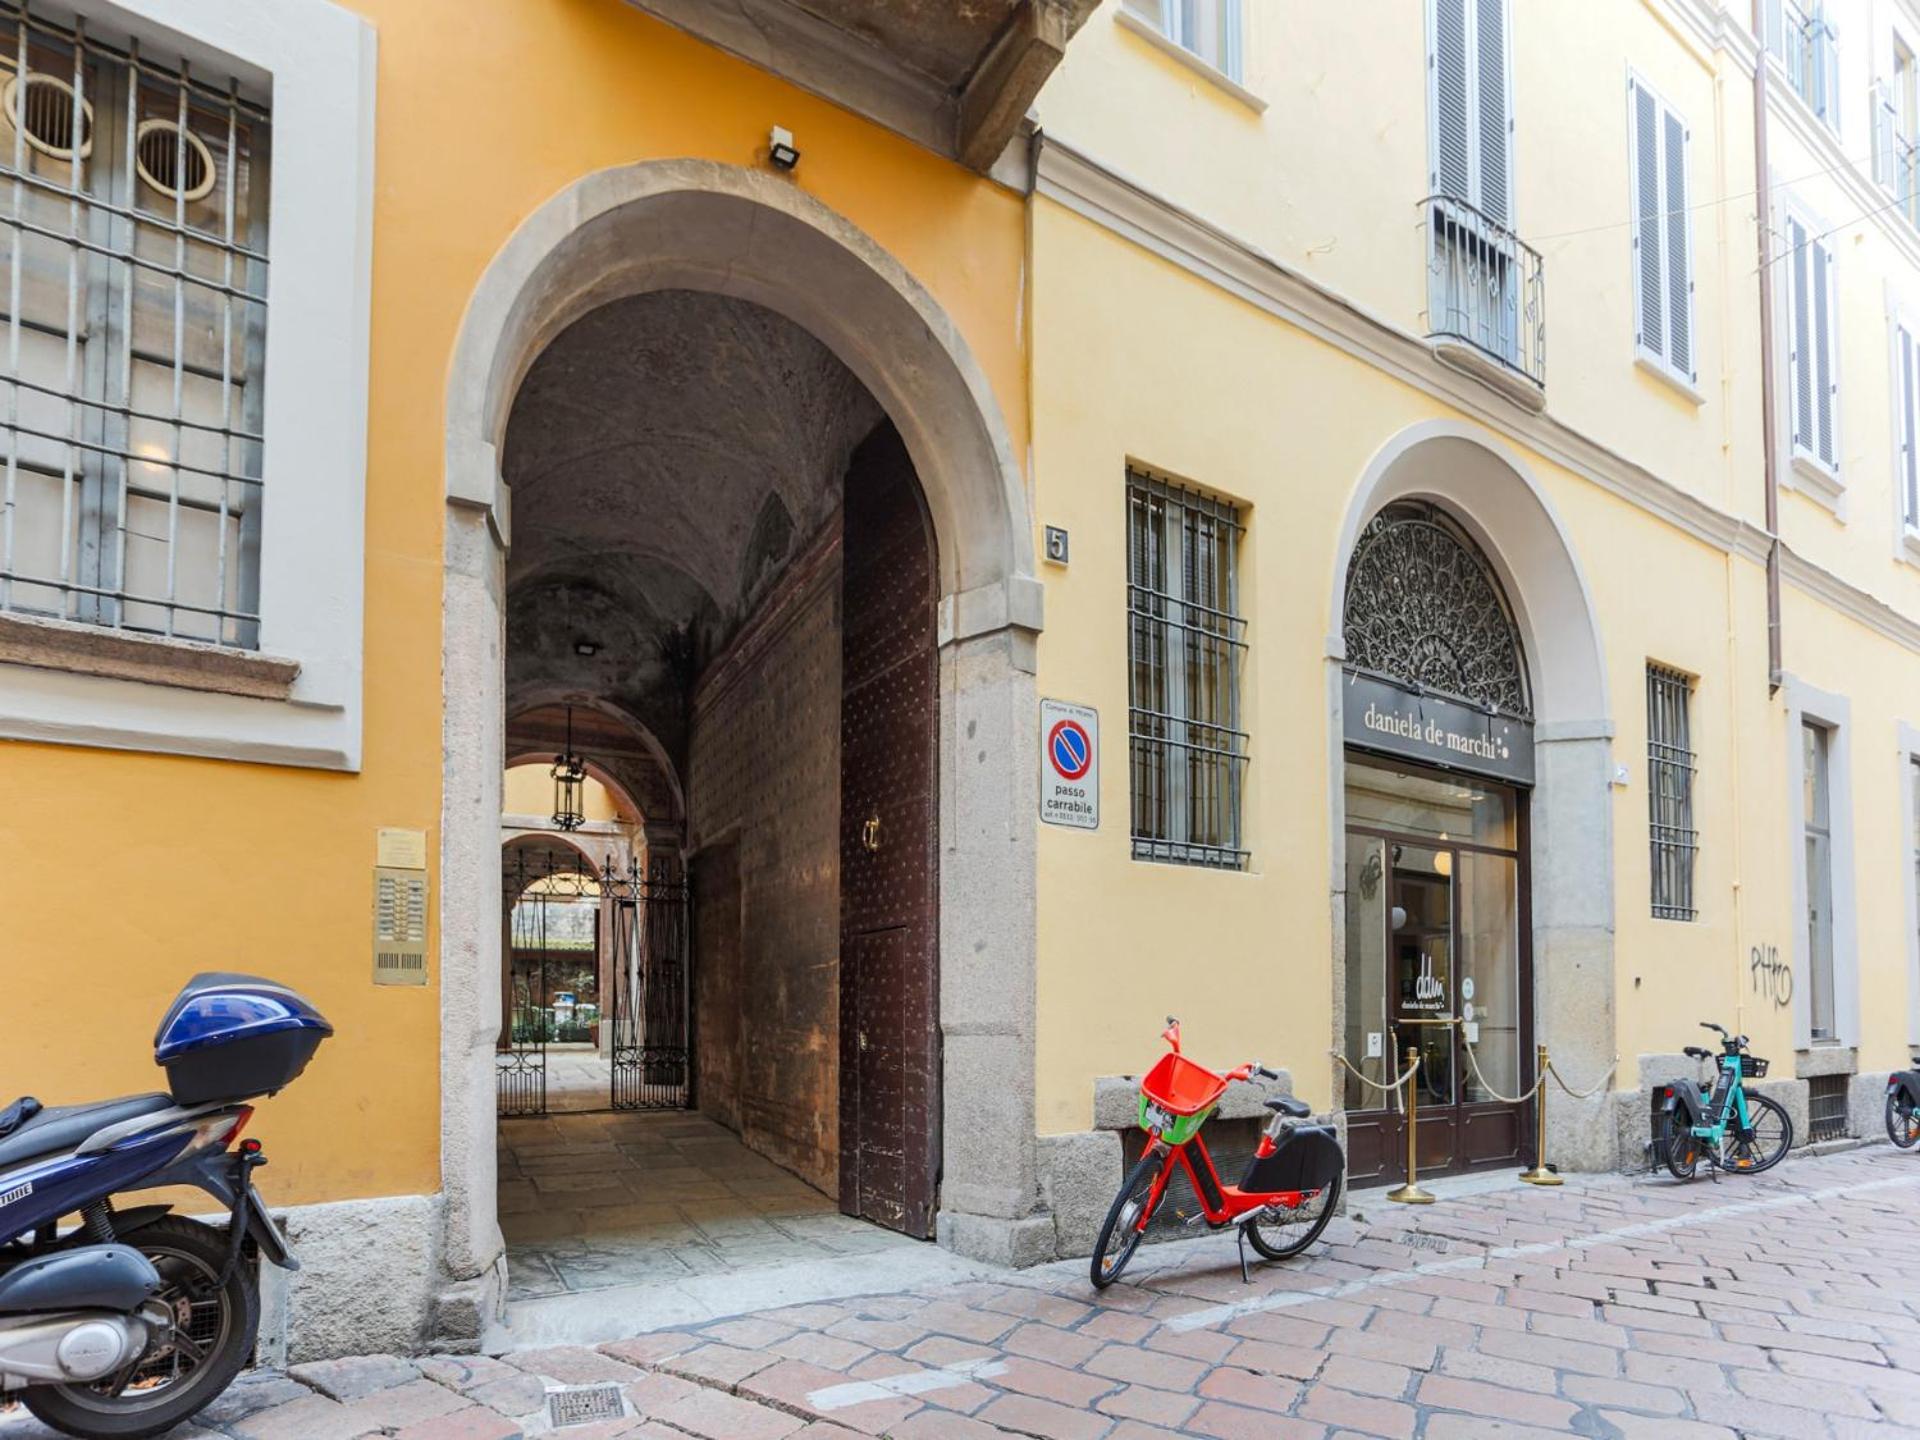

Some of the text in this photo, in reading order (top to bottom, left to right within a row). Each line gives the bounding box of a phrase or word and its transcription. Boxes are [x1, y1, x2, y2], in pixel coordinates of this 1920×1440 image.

[1051, 530, 1063, 558] 5
[1364, 703, 1496, 760] daniela de marchi
[1055, 785, 1085, 798] passo
[1047, 799, 1093, 814] carrabile
